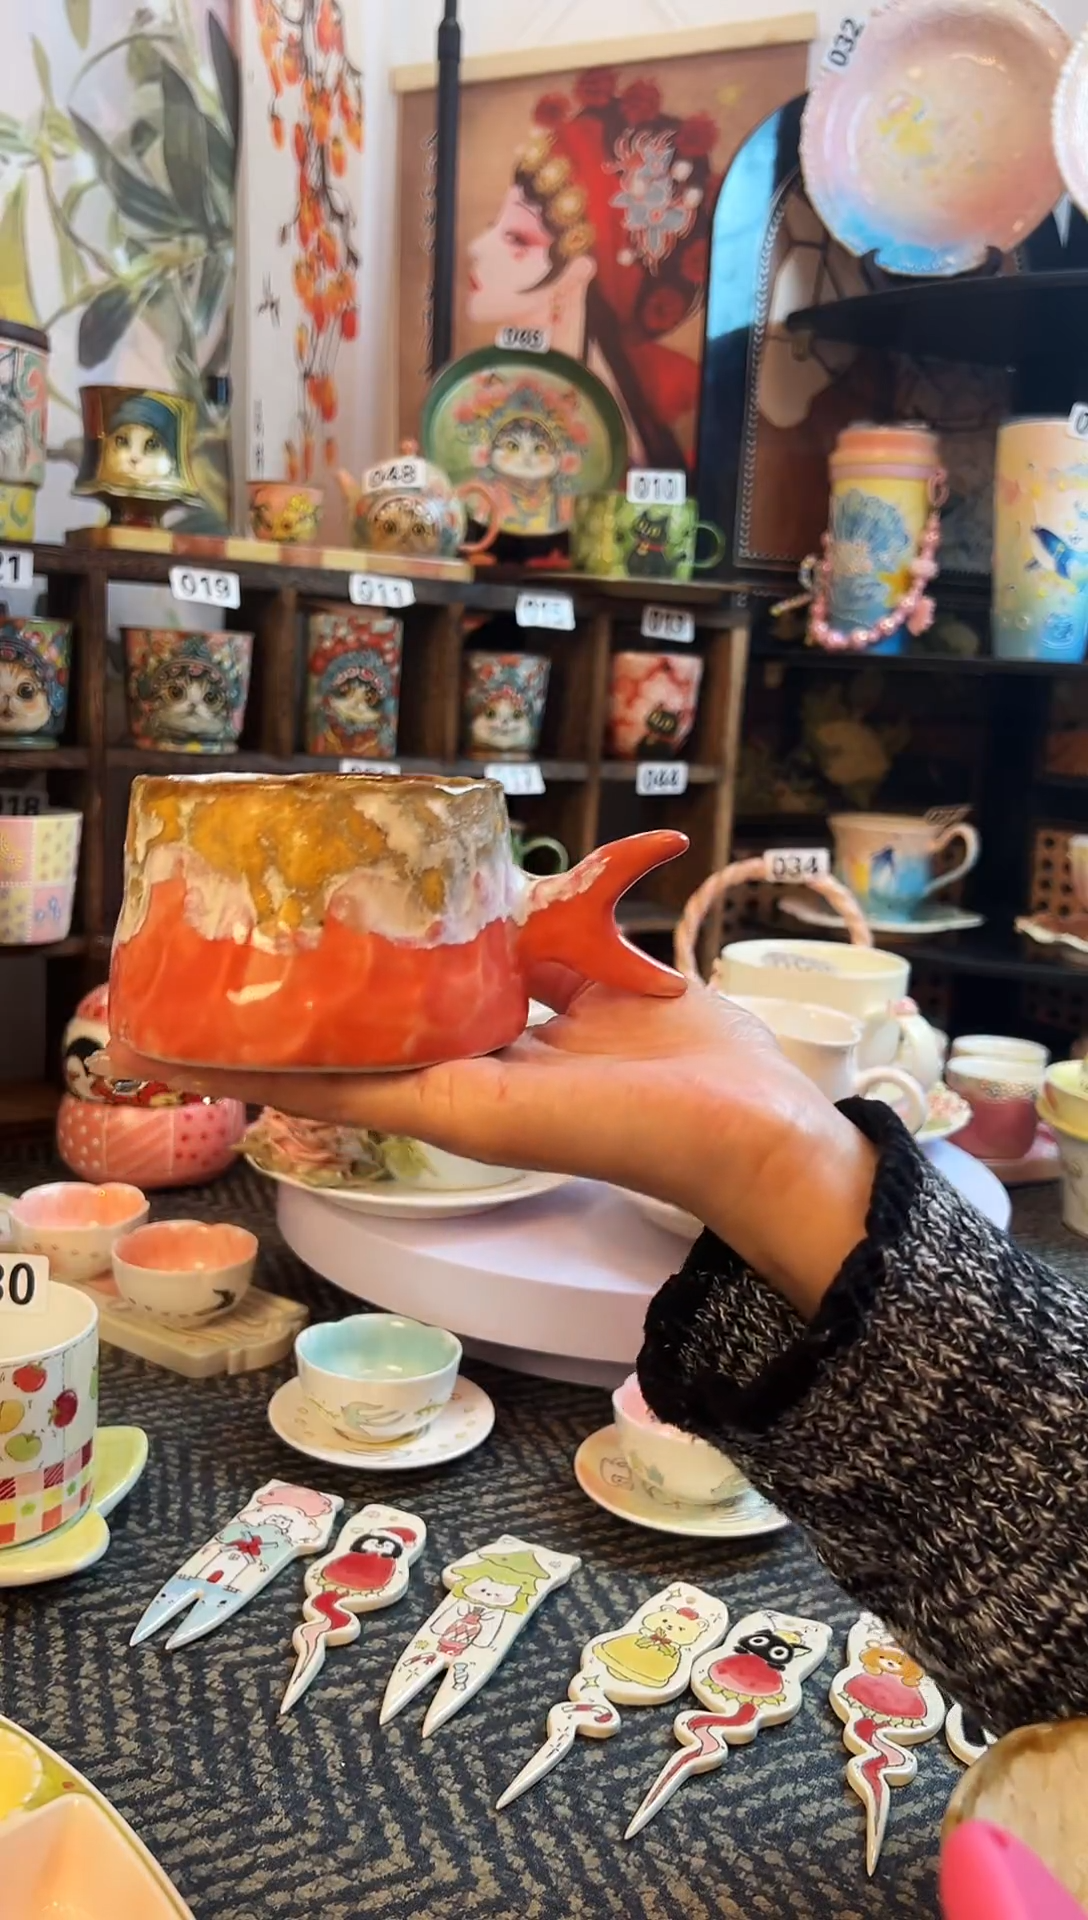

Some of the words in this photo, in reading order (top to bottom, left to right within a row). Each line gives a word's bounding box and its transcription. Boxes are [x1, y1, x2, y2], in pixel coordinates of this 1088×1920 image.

[830, 18, 865, 66] 032
[0, 551, 20, 582] 1
[181, 573, 230, 598] 019
[0, 795, 40, 816] 18
[773, 856, 818, 880] 034
[0, 1262, 35, 1305] 0
